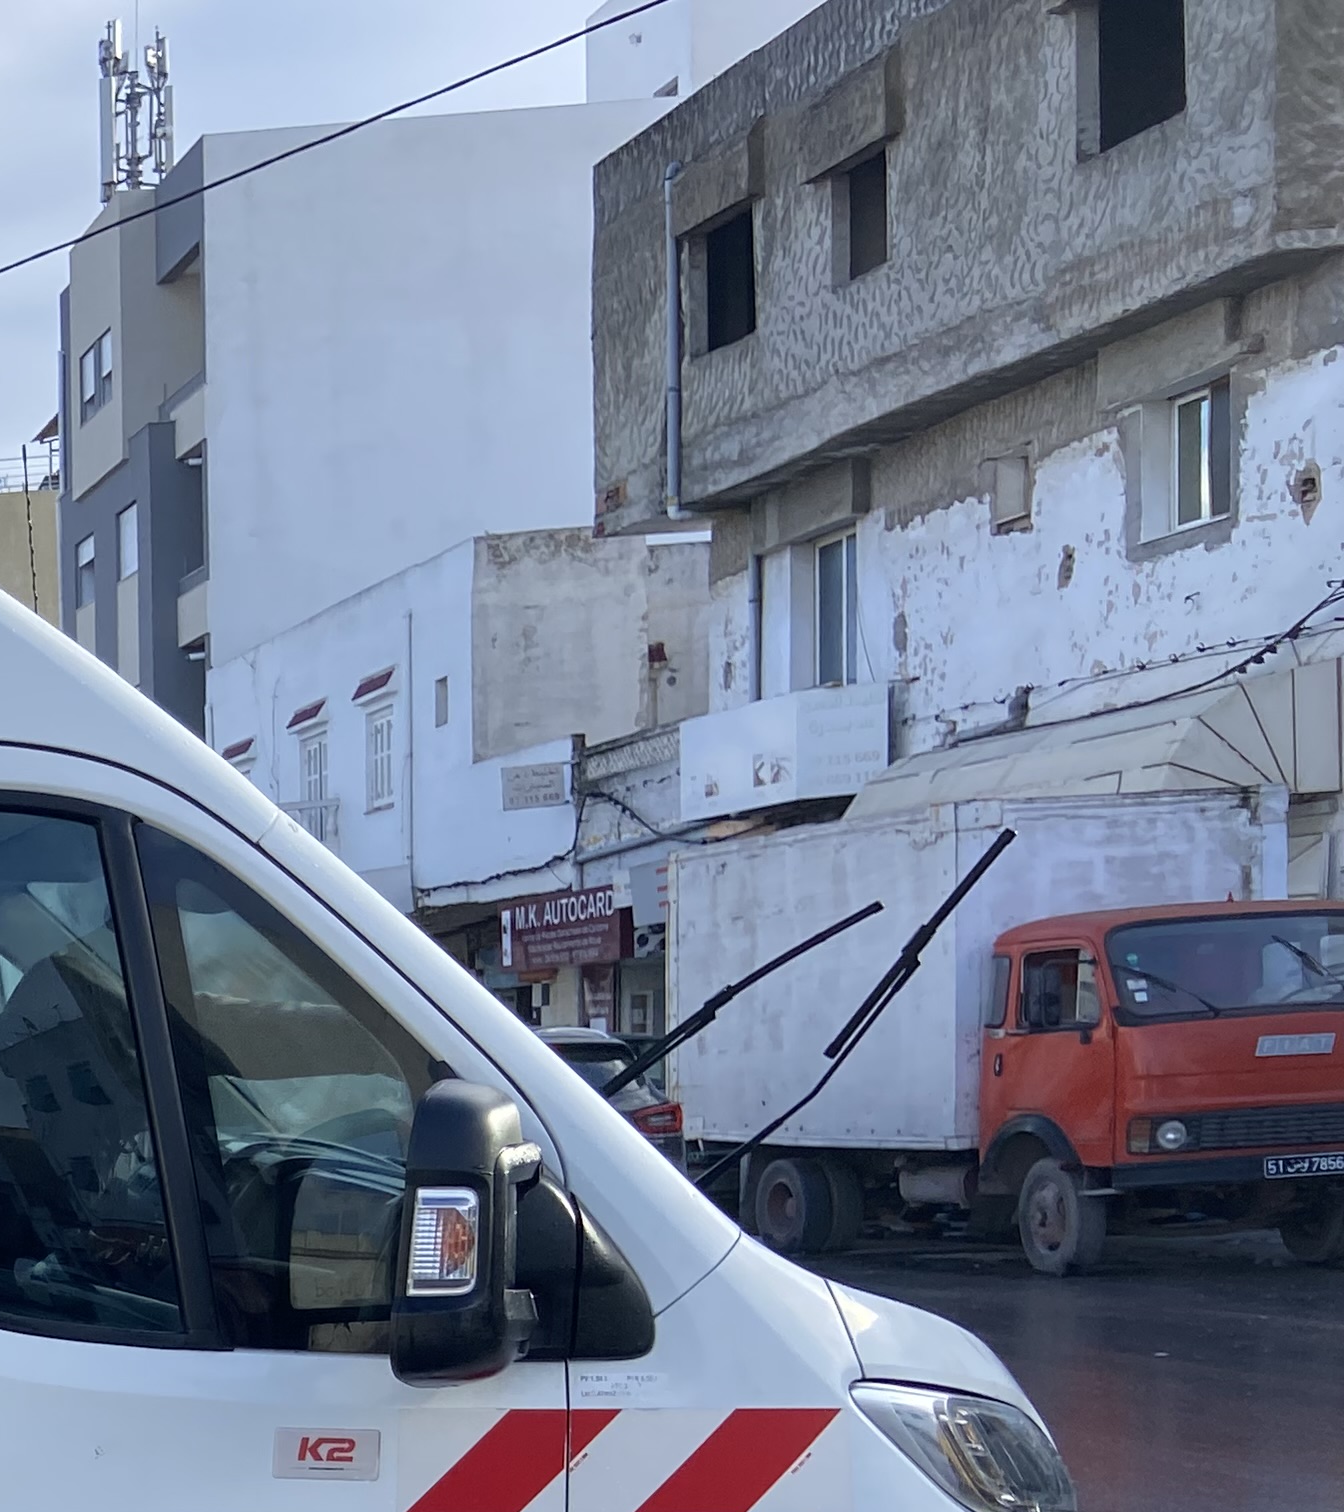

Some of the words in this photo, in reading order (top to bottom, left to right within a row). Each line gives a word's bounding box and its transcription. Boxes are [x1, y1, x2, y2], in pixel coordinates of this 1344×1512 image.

[515, 904, 541, 931] M.K.
[543, 890, 615, 926] AUTOCARD
[1262, 1037, 1328, 1053] FIAT
[1267, 1160, 1284, 1174] 51
[1311, 1156, 1344, 1172] 7856
[297, 1437, 356, 1462] K2
